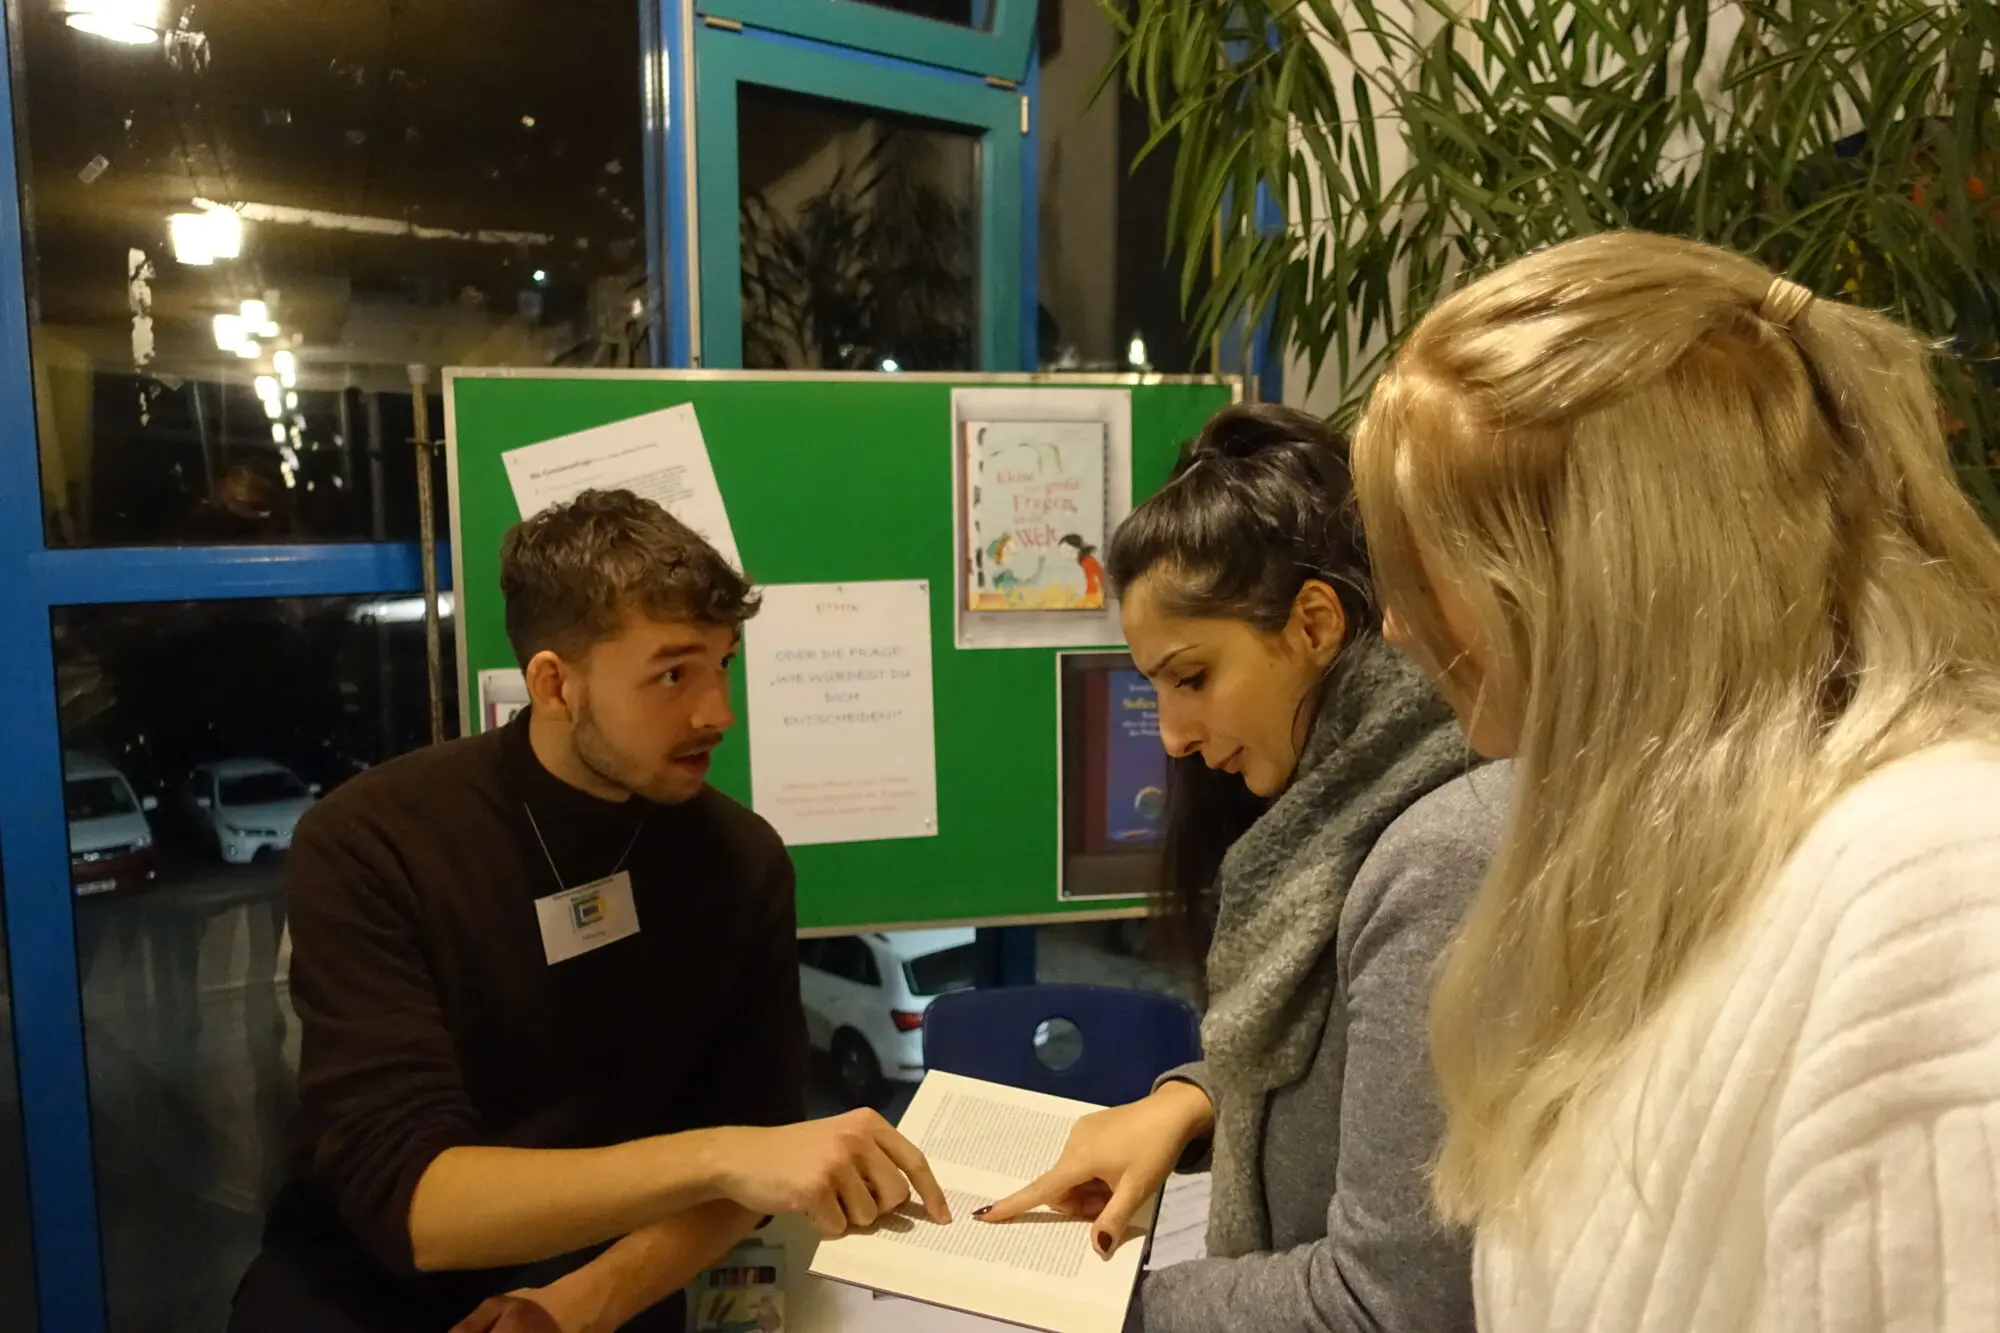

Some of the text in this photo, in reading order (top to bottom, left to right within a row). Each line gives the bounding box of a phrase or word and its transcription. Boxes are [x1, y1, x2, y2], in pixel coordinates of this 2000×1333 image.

[1015, 523, 1057, 547] Welt
[821, 647, 843, 660] DIE
[890, 668, 911, 679] DU
[824, 691, 860, 703] DICH
